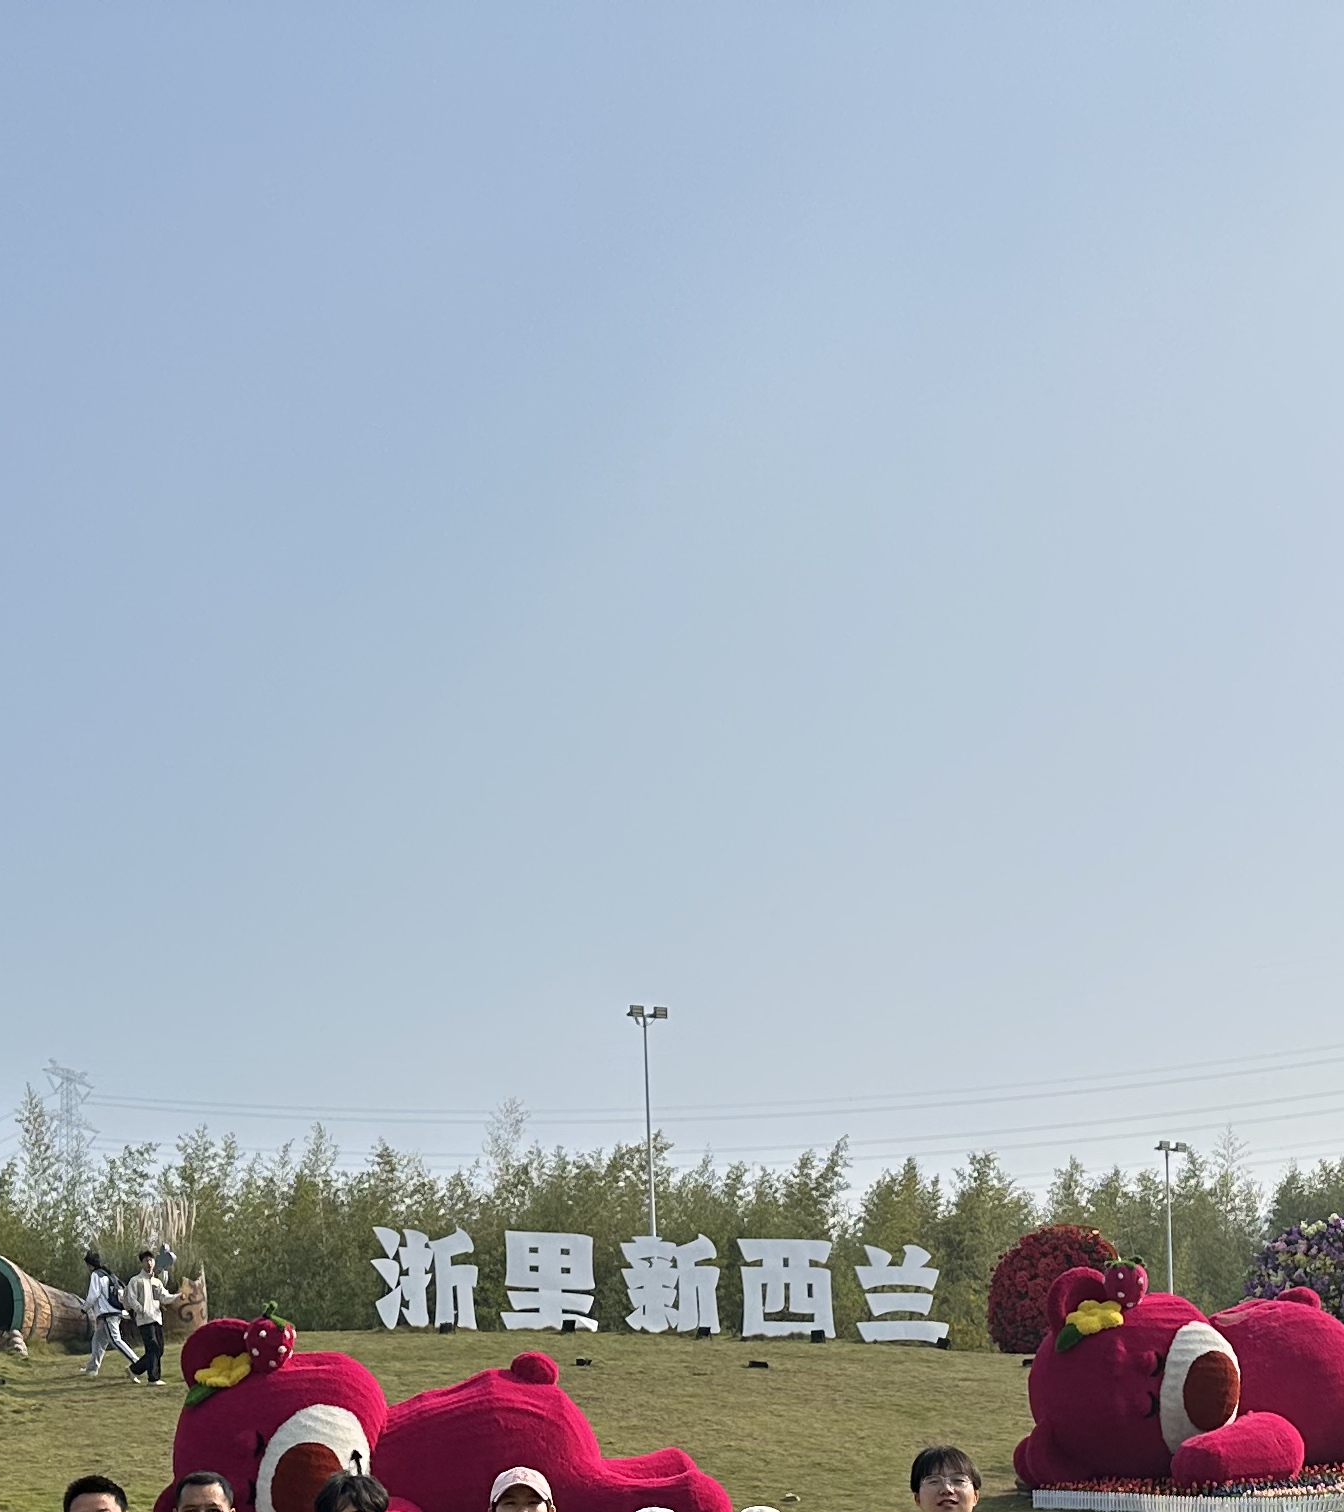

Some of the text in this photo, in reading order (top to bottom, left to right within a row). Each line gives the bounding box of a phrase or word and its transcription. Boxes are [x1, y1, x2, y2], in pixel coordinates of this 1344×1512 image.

[371, 1226, 949, 1344] 浙里新西兰
